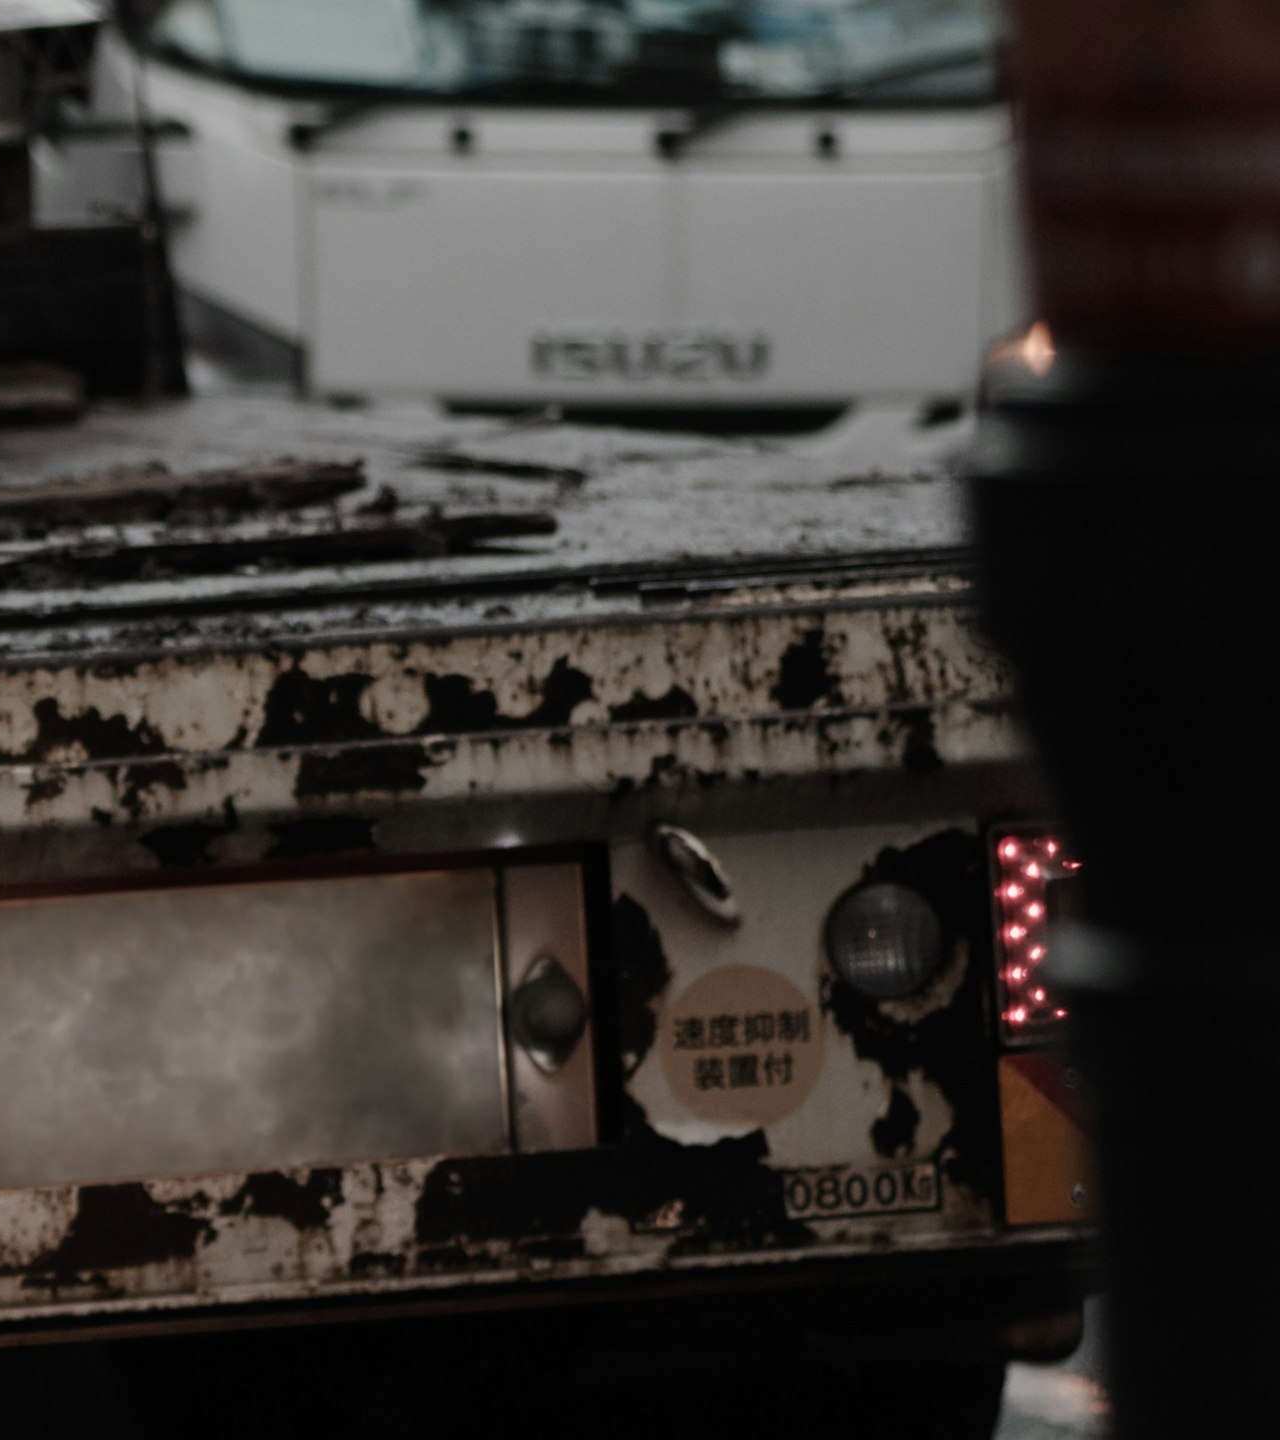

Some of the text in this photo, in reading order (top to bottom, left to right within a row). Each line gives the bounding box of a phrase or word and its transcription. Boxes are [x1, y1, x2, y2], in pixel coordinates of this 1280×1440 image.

[528, 336, 772, 382] ISUZU
[674, 1010, 810, 1050] 速度抑制
[695, 1052, 793, 1090] 装置付
